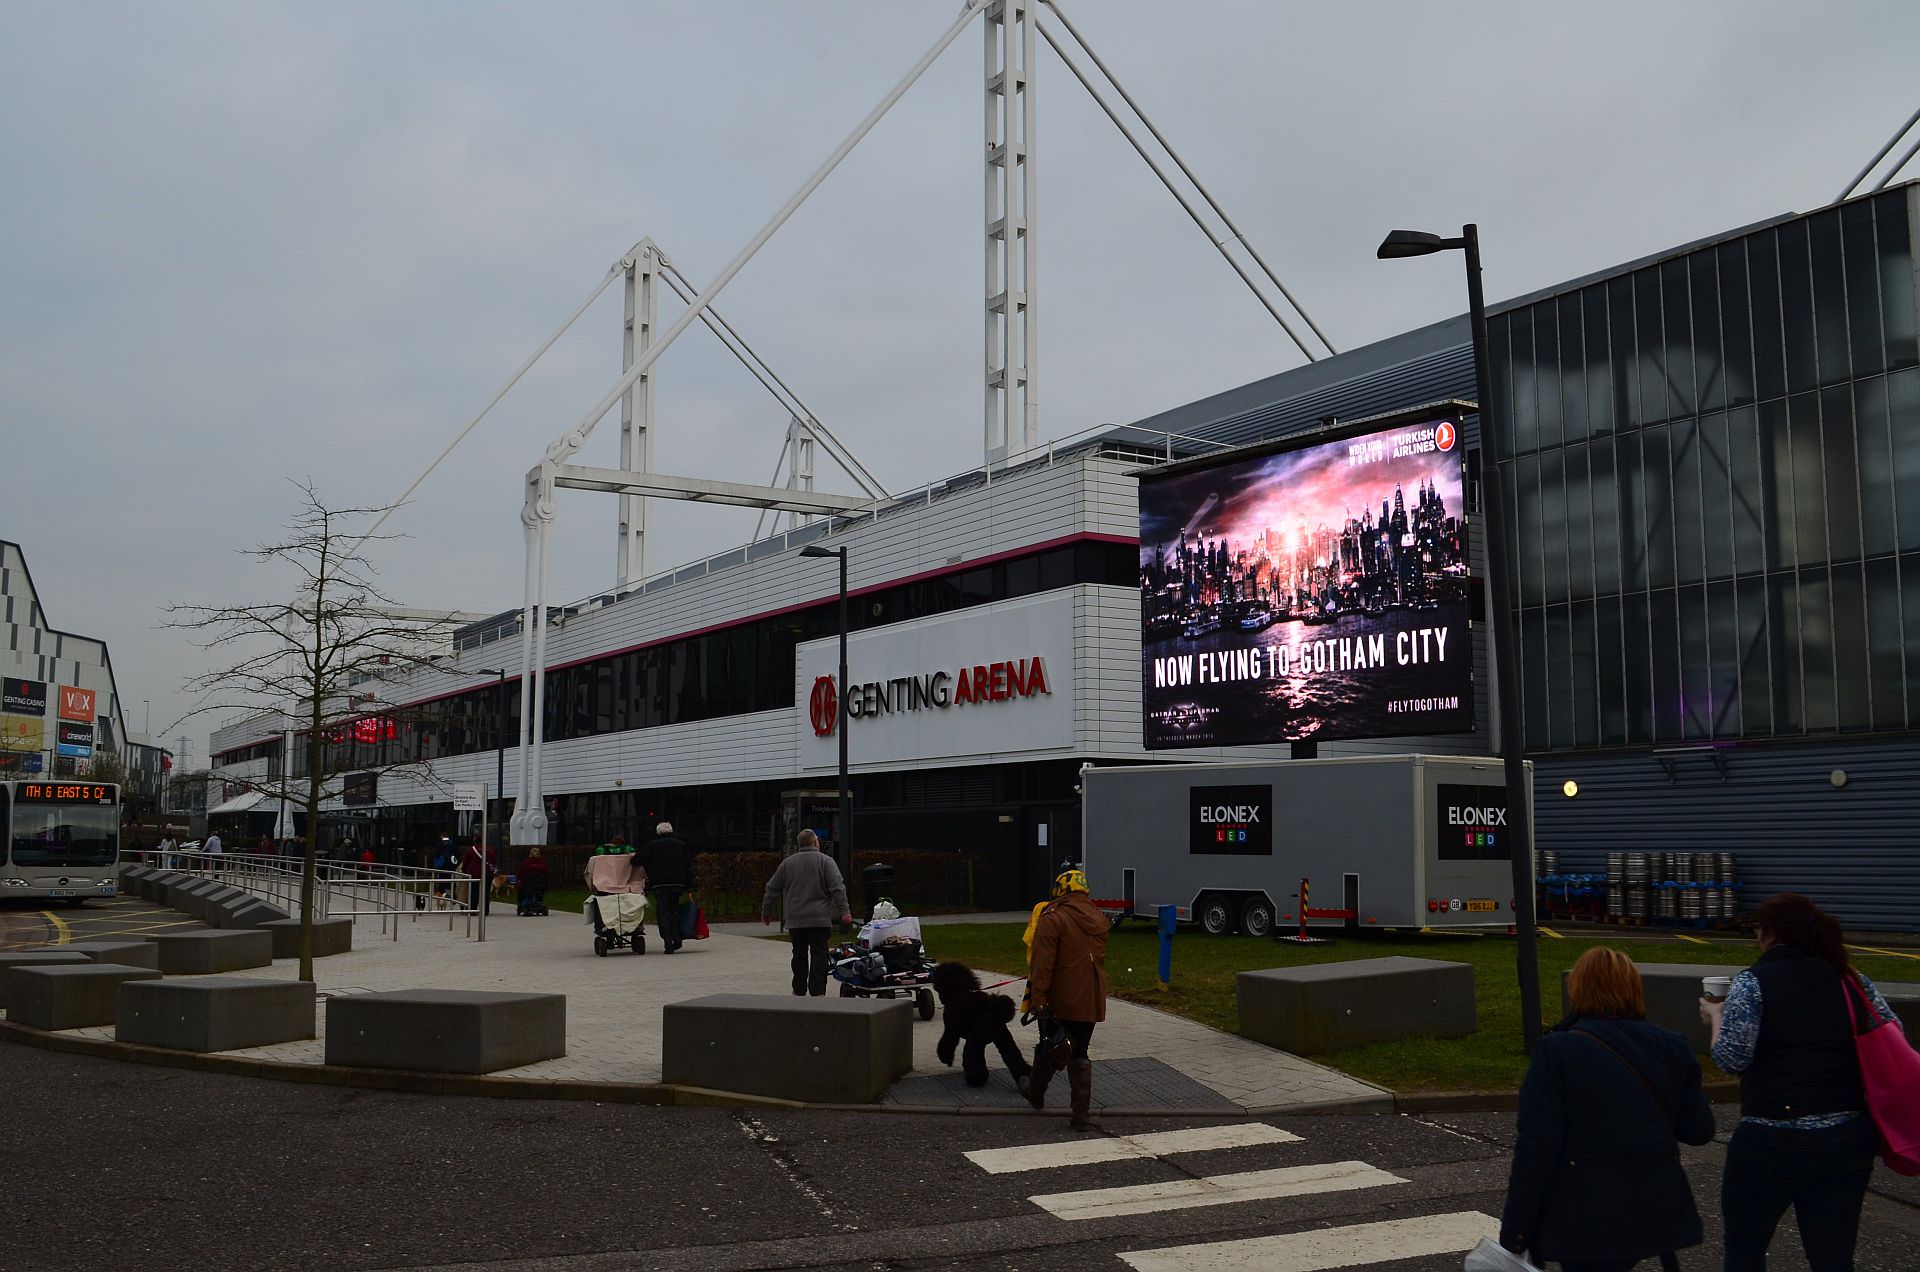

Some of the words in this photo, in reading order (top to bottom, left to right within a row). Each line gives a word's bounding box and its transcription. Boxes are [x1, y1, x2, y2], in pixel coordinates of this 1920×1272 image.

[1392, 428, 1435, 447] TURKISH
[1349, 450, 1383, 467] WORLD
[1392, 440, 1436, 459] AIRLINES
[1154, 654, 1193, 689] NOW
[1198, 648, 1262, 685] FLYING
[1267, 645, 1289, 677] TO
[1300, 634, 1385, 675] GOTHAM
[1396, 627, 1448, 665] CITY
[847, 671, 949, 719] GENTING
[954, 657, 1049, 705] ARENA
[1387, 696, 1459, 714] #FLYTOGOTHAM
[67, 731, 92, 742] cineworld
[45, 786, 53, 798] &
[57, 786, 80, 798] EAST
[82, 787, 89, 799] 5
[1200, 805, 1260, 823] ELONEX
[1448, 806, 1507, 826] ELONEX
[1217, 831, 1247, 842] LED
[1466, 833, 1495, 845] LED
[1451, 900, 1461, 910] GB
